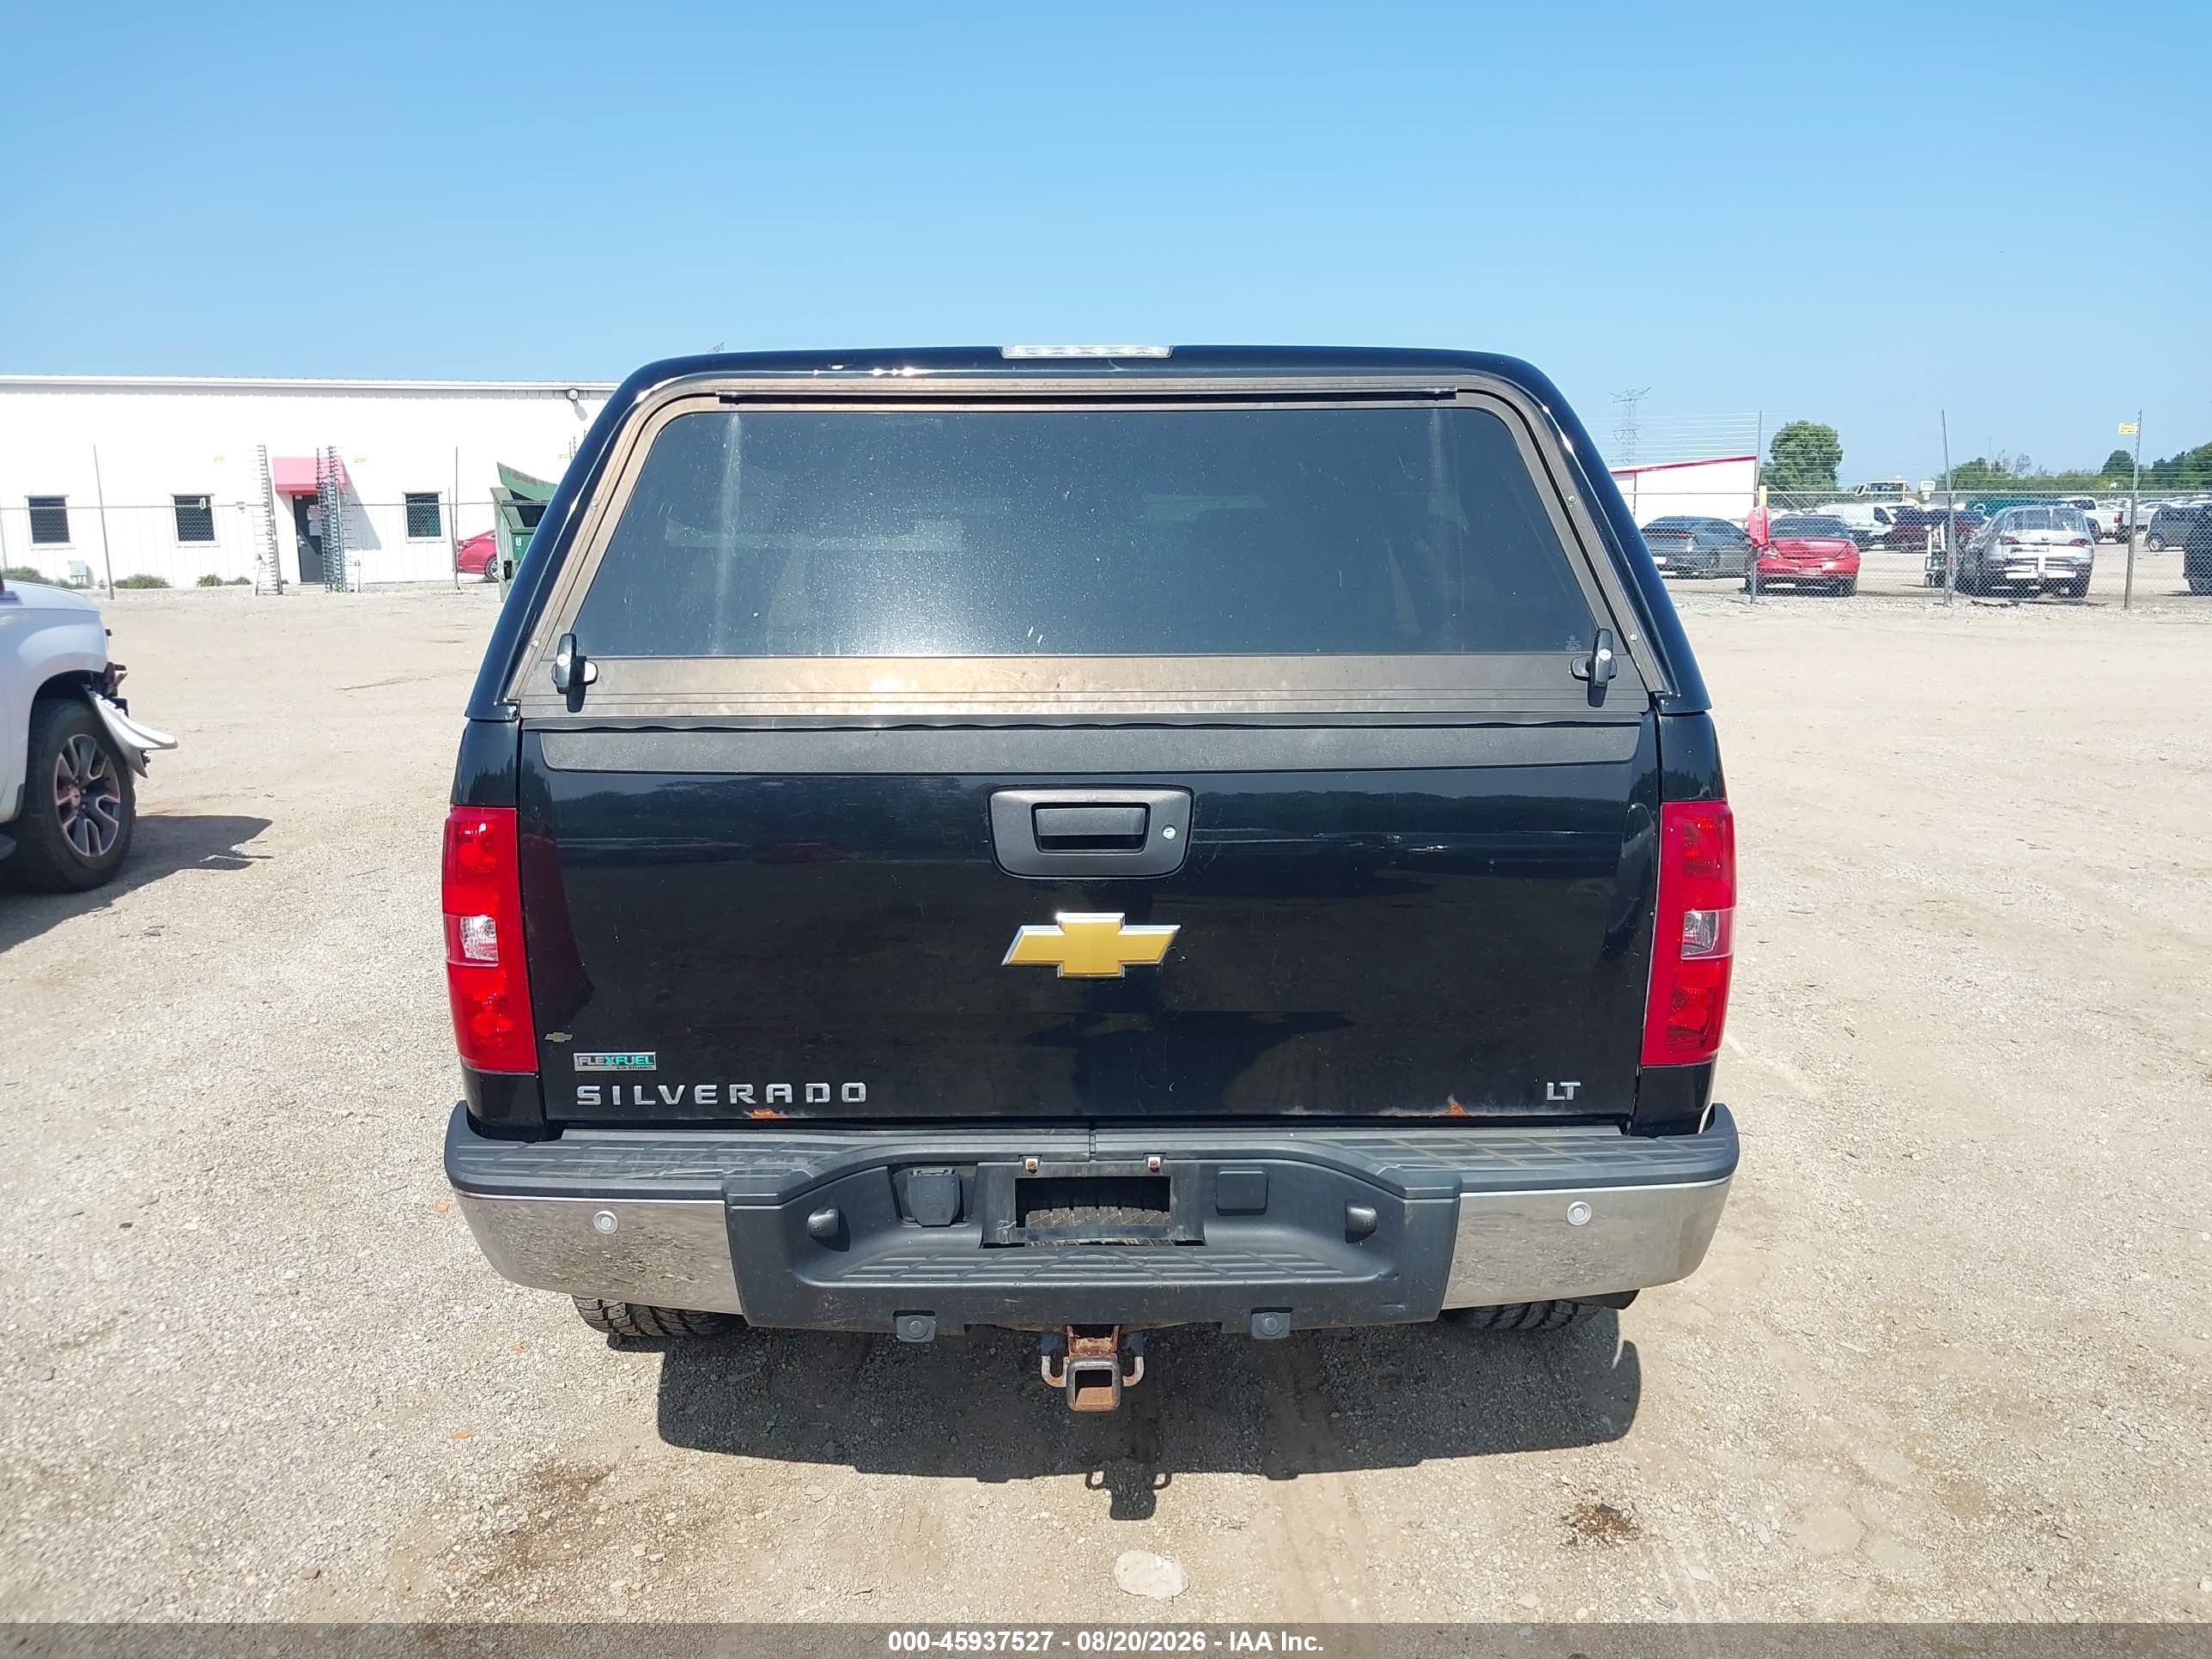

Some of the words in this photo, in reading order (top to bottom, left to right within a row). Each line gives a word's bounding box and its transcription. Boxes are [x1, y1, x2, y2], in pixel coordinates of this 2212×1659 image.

[578, 1055, 653, 1066] FLEXFUEL
[576, 1082, 866, 1105] SILVERADO
[1547, 1081, 1582, 1101] LT
